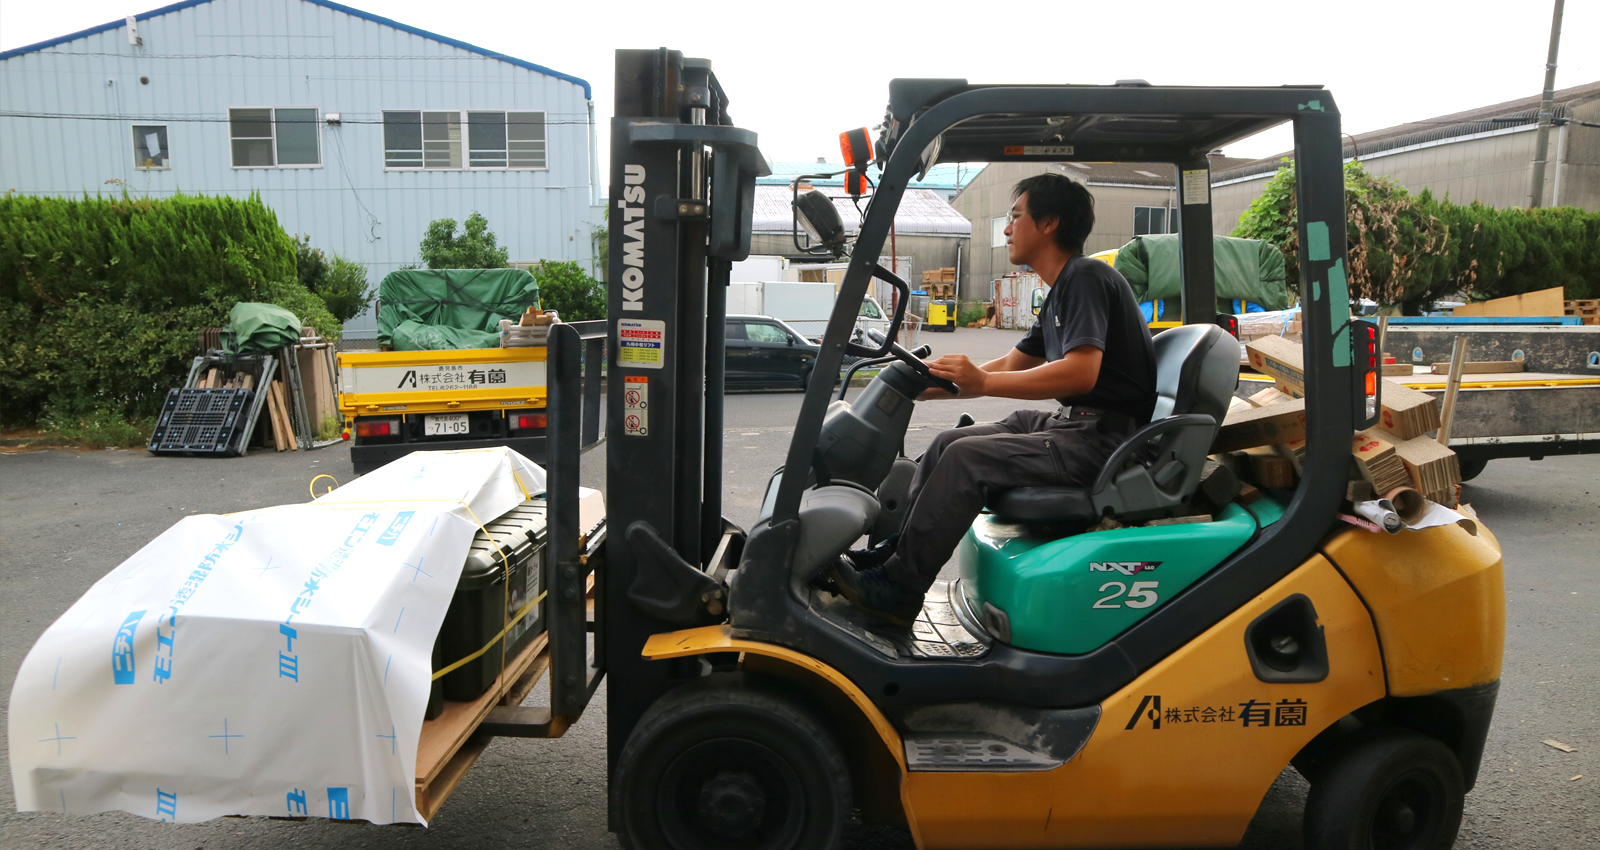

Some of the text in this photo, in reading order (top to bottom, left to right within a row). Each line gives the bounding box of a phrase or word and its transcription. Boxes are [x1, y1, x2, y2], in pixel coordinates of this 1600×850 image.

[617, 164, 646, 311] KOMATSU
[434, 421, 467, 433] 71-05
[1089, 561, 1142, 576] NXT
[1092, 581, 1159, 609] 25
